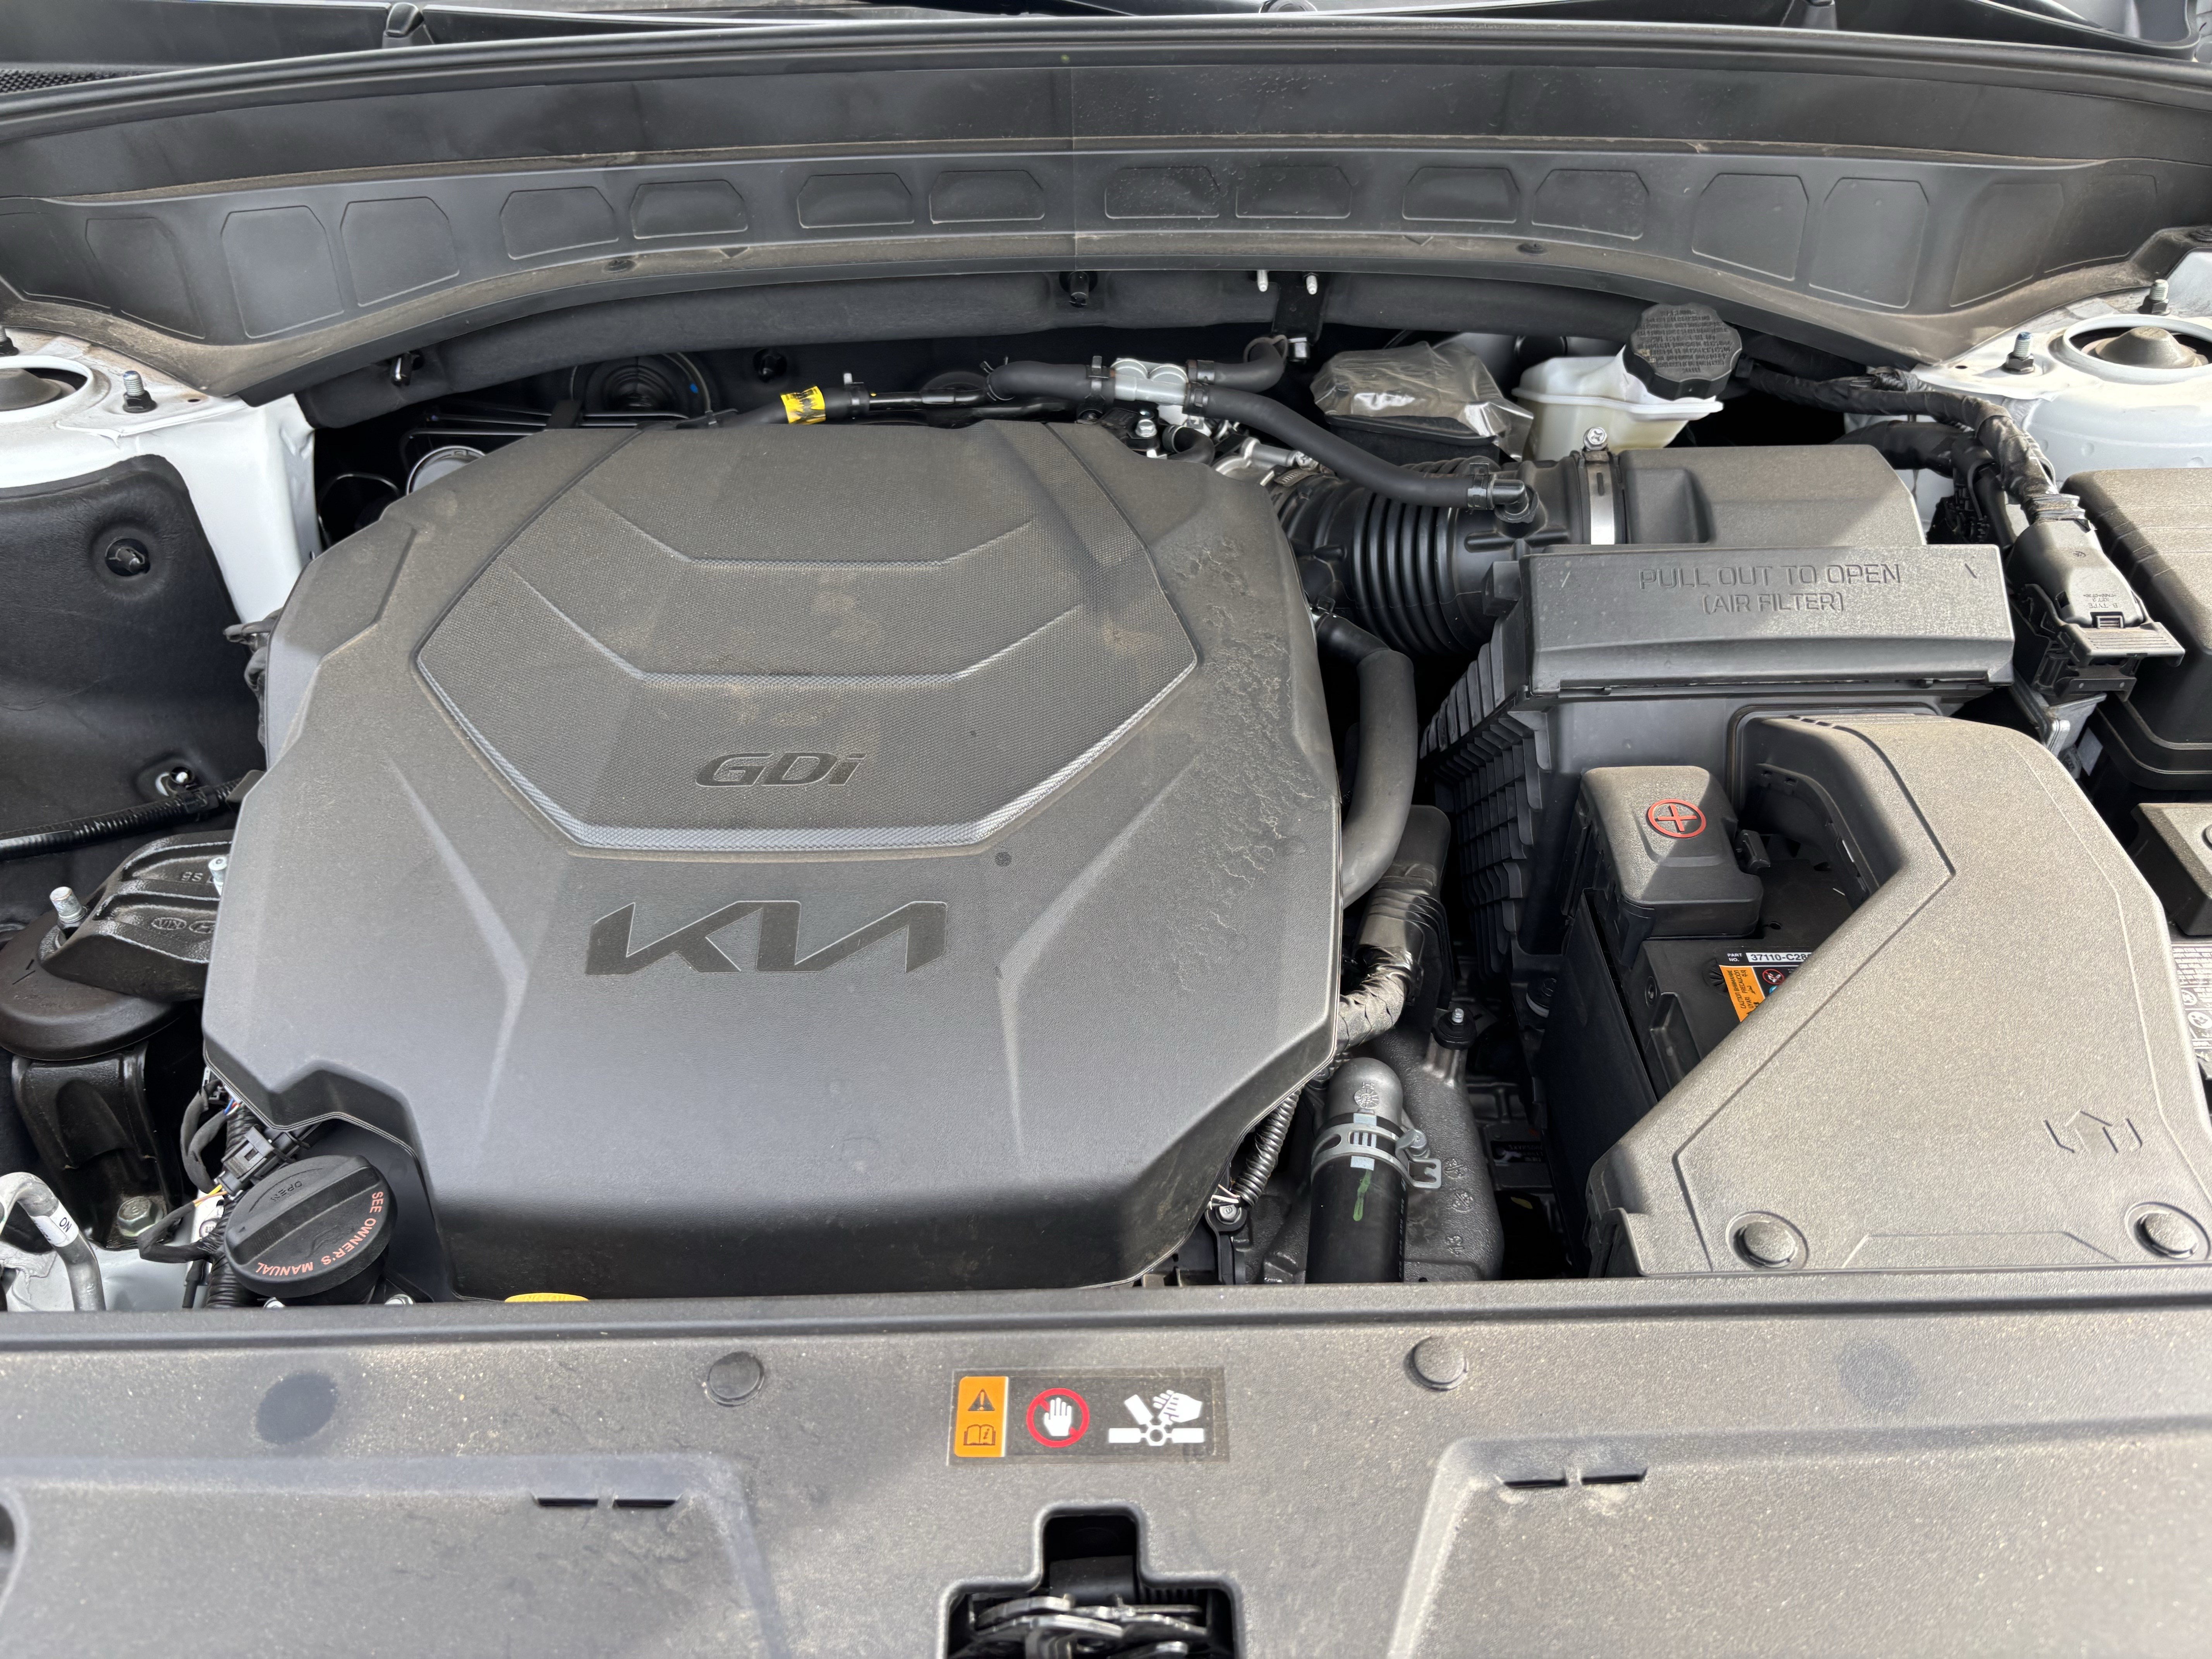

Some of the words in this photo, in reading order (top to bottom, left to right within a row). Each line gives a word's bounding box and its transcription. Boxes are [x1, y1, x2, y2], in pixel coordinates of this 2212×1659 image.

[1639, 567, 1710, 589] PULL
[1717, 566, 1772, 587] OUT
[1779, 565, 1817, 586] TO
[1826, 564, 1901, 584] OPEN
[1702, 593, 1751, 614] (AIR
[1757, 592, 1844, 612] FILTER)
[696, 752, 867, 787] GDi
[585, 900, 948, 976] KIA
[271, 1181, 303, 1201] OPEN
[369, 1191, 384, 1213] SEE
[321, 1218, 376, 1265] OWNER'S
[256, 1262, 313, 1276] MANUAL
